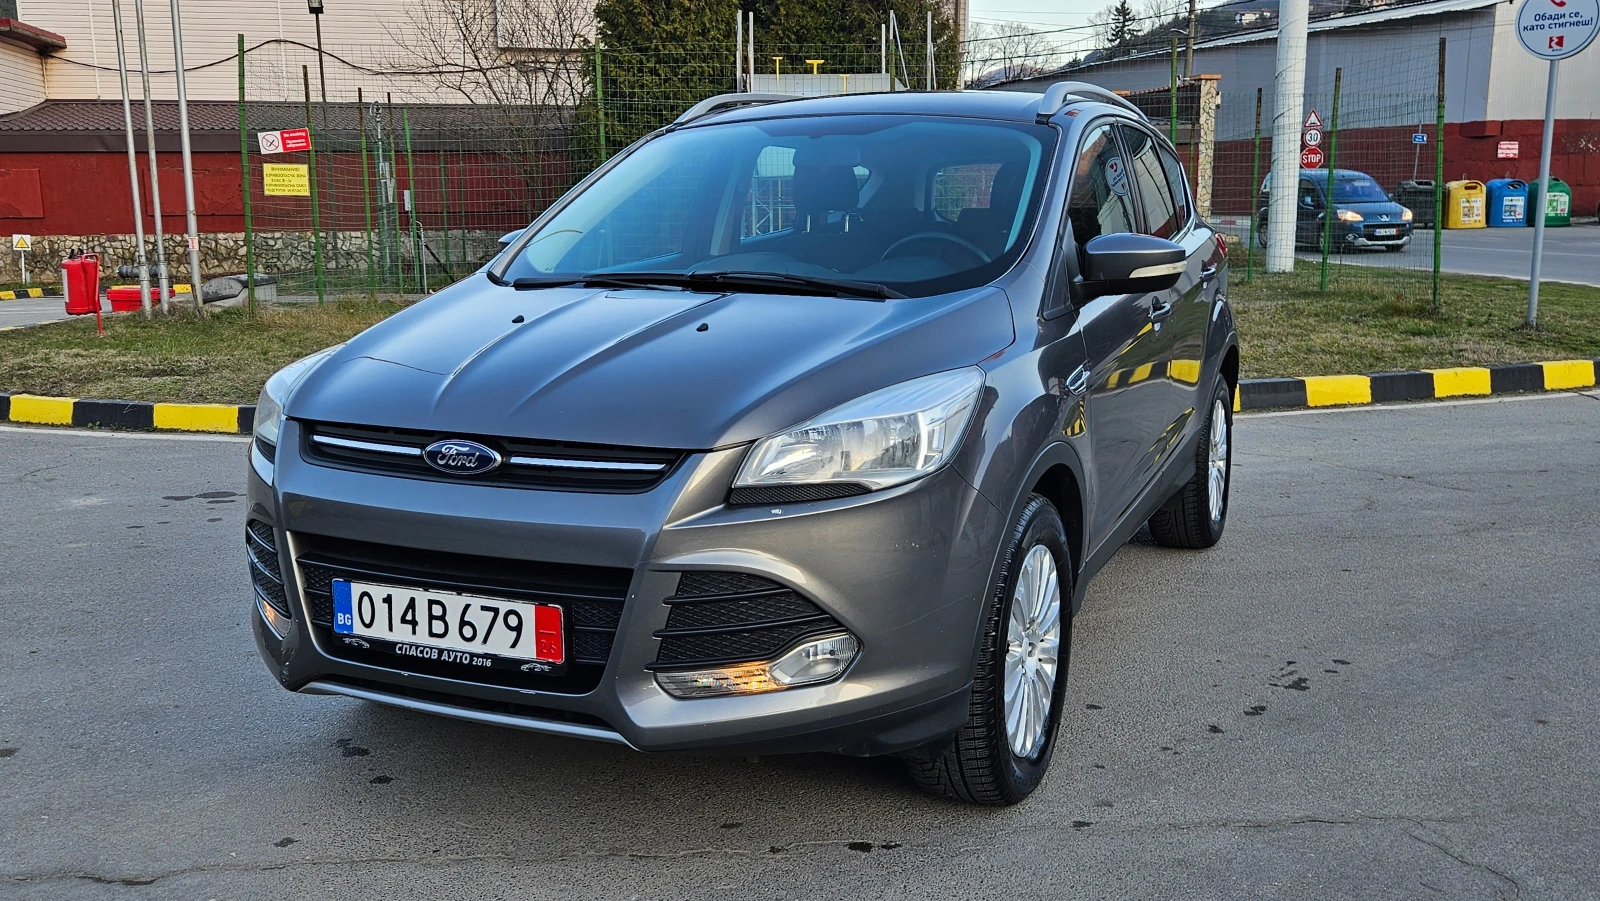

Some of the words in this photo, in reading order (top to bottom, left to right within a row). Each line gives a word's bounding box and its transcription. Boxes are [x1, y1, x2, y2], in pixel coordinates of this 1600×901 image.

[1534, 12, 1566, 22] Обади
[1568, 11, 1583, 19] се,
[1523, 23, 1545, 32] като
[1548, 17, 1593, 29] стигнеш!
[1307, 132, 1319, 143] 30
[1302, 154, 1321, 163] STOP
[437, 444, 480, 467] Ford
[337, 613, 352, 626] BG
[395, 643, 439, 660] СПАСОВ
[441, 651, 470, 664] АУТО
[472, 656, 492, 668] 2016
